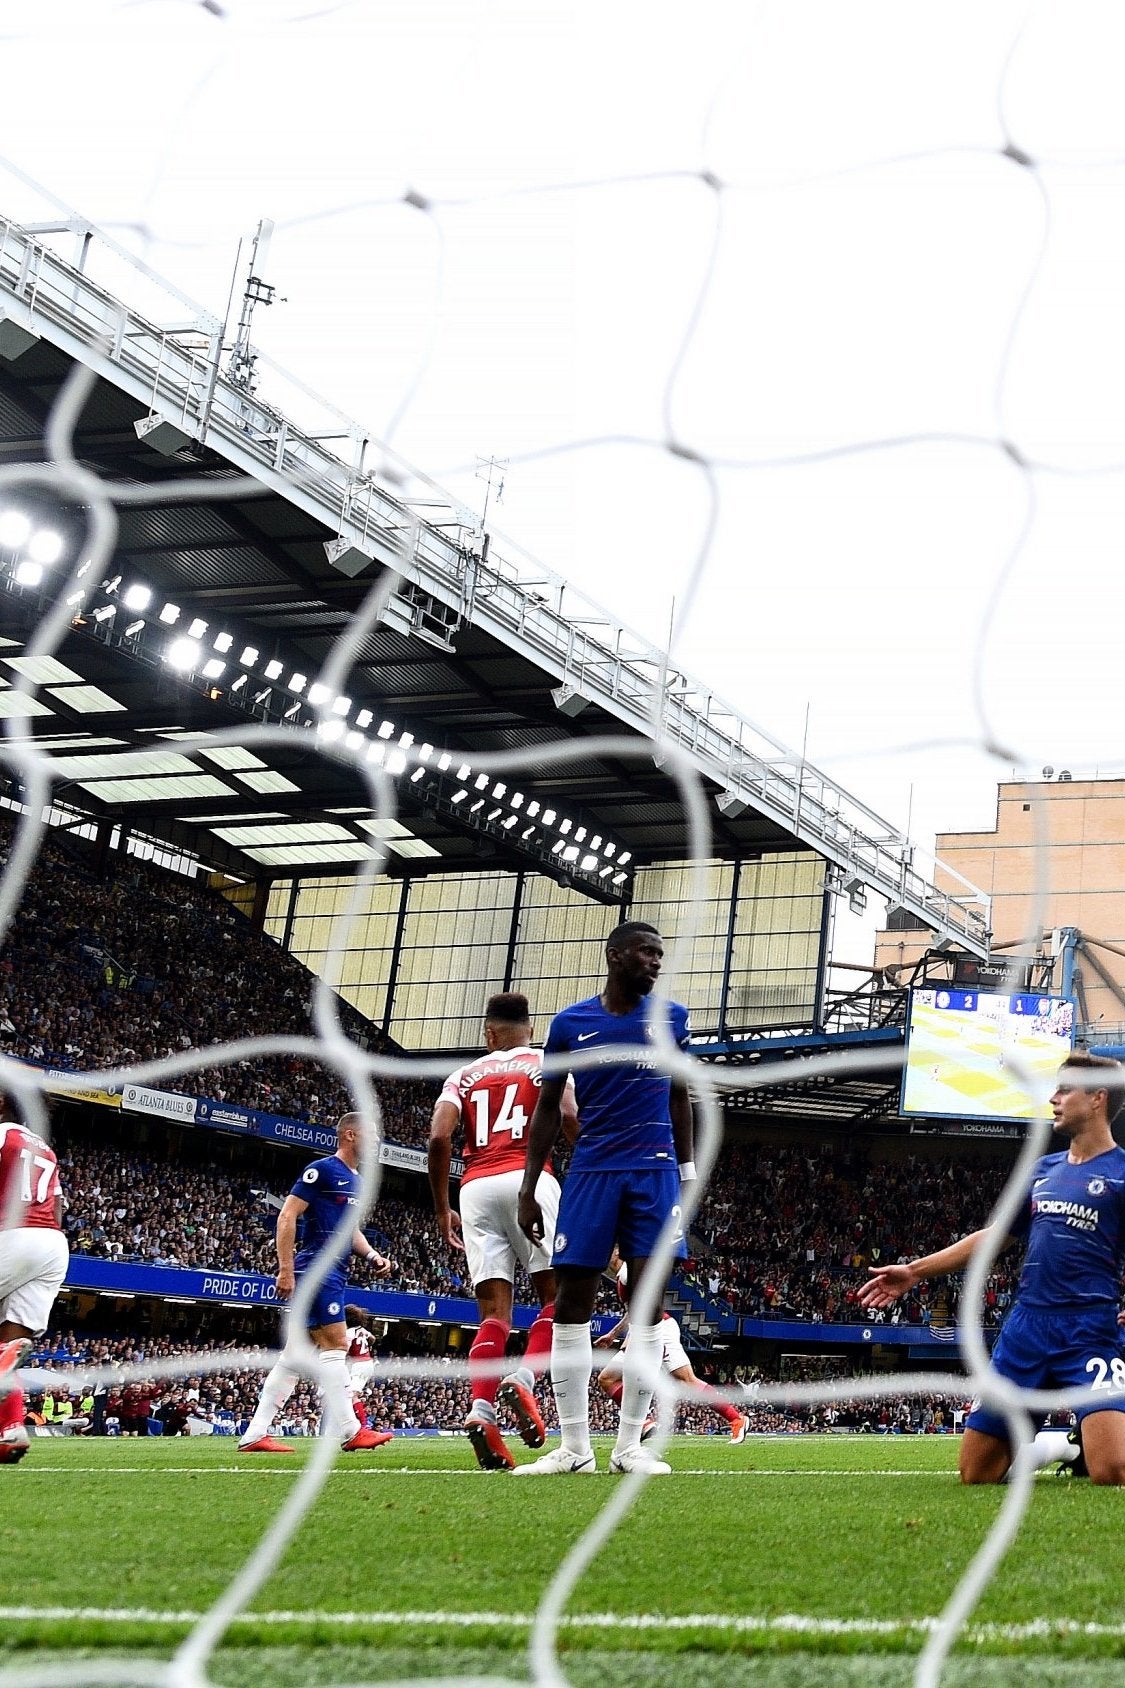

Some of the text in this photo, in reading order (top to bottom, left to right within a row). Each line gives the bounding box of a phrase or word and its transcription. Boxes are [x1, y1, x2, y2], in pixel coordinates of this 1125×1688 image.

[965, 995, 973, 1008] 2
[1016, 999, 1023, 1012] 1
[599, 1051, 660, 1064] YOKOHAM
[635, 1062, 659, 1070] TYRE
[458, 1060, 542, 1099] AUBAMEYANG
[138, 1094, 184, 1114] ATLANTA BLUES
[470, 1083, 529, 1148] 14
[275, 1123, 313, 1143] CHELSEA
[962, 1124, 1005, 1134] YOKOHAMA
[20, 1148, 57, 1204] 17
[1037, 1200, 1099, 1224] YOKOHAMA
[1065, 1216, 1096, 1232] TYRES
[202, 1278, 239, 1296] PRIDE
[242, 1282, 259, 1298] OF
